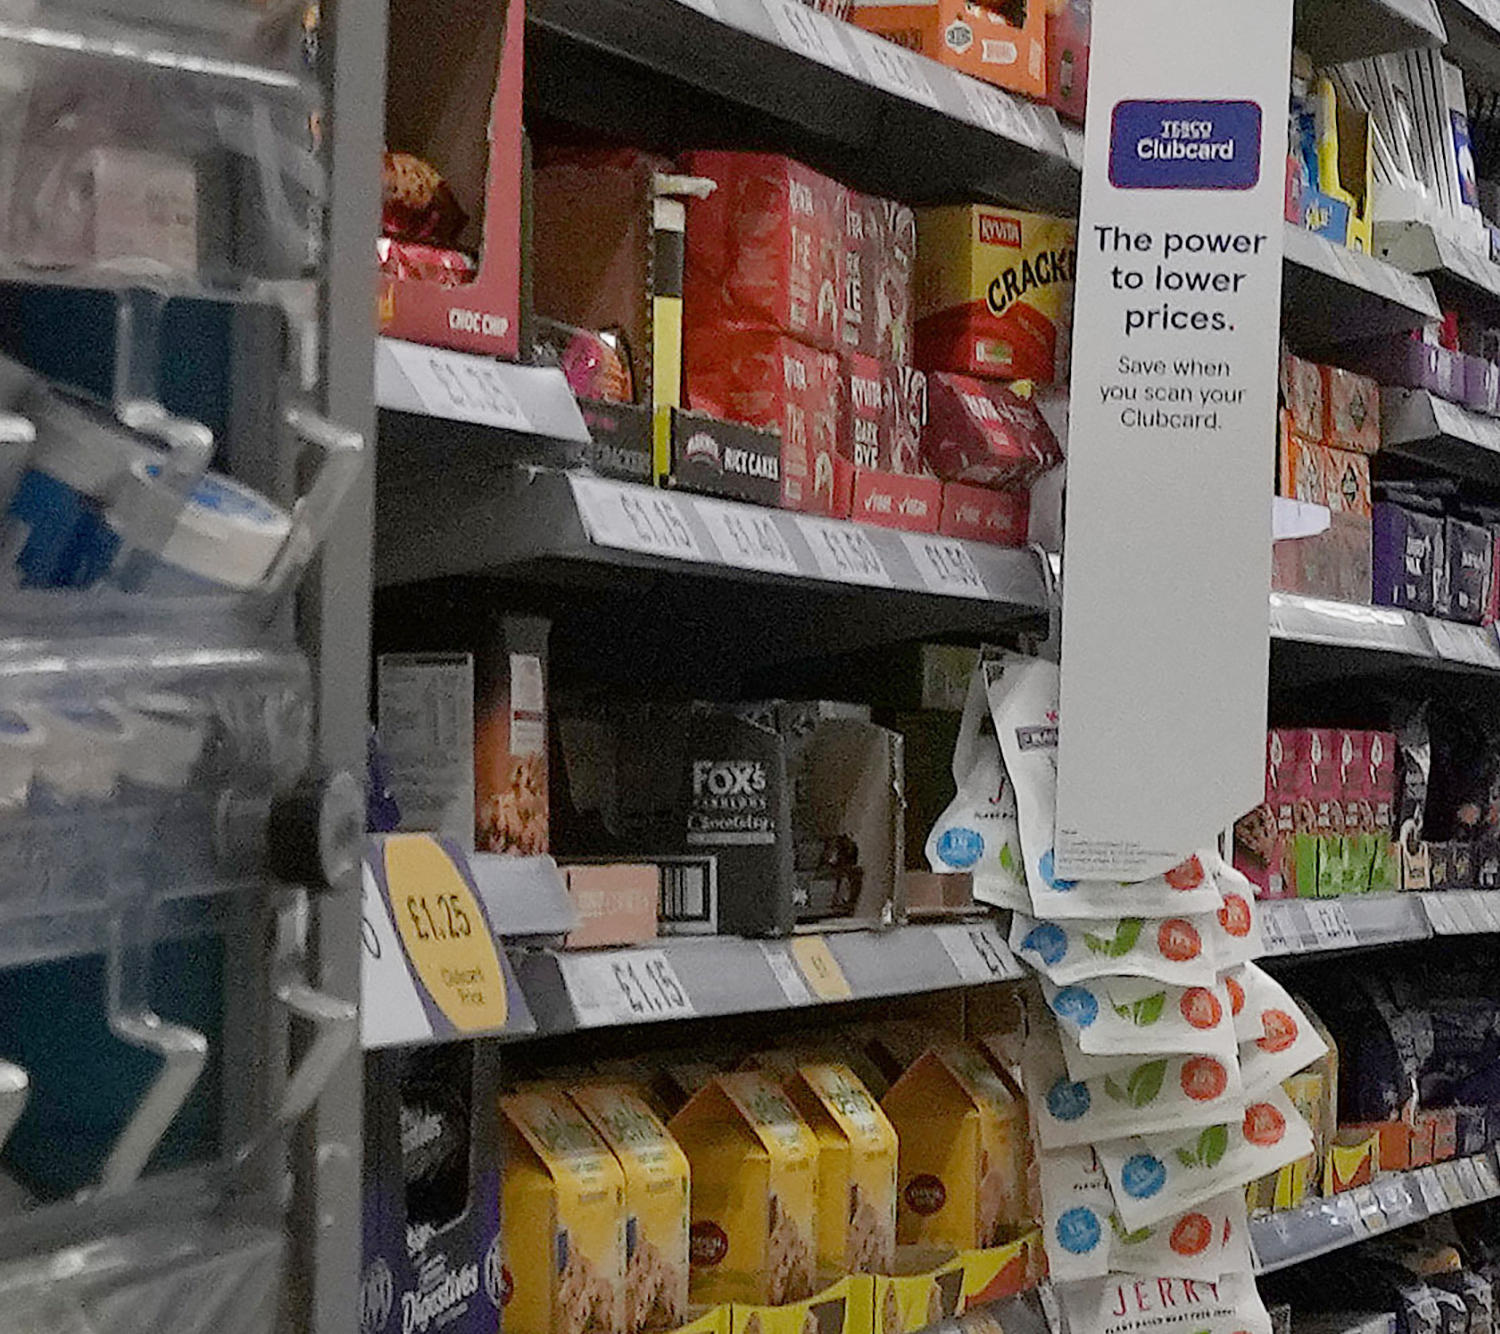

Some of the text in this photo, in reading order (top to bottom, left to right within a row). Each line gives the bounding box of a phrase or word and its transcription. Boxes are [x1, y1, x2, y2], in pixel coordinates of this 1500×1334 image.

[1136, 137, 1236, 162] Clubcard
[1094, 224, 1267, 259] The power
[1110, 265, 1248, 293] to lower
[1124, 303, 1235, 337] prices.
[1117, 355, 1231, 378] Save when
[1098, 382, 1247, 409] you scan your
[1120, 408, 1222, 431] Clubcard.
[405, 893, 472, 943] £1.25
[610, 961, 685, 1016] £1.15
